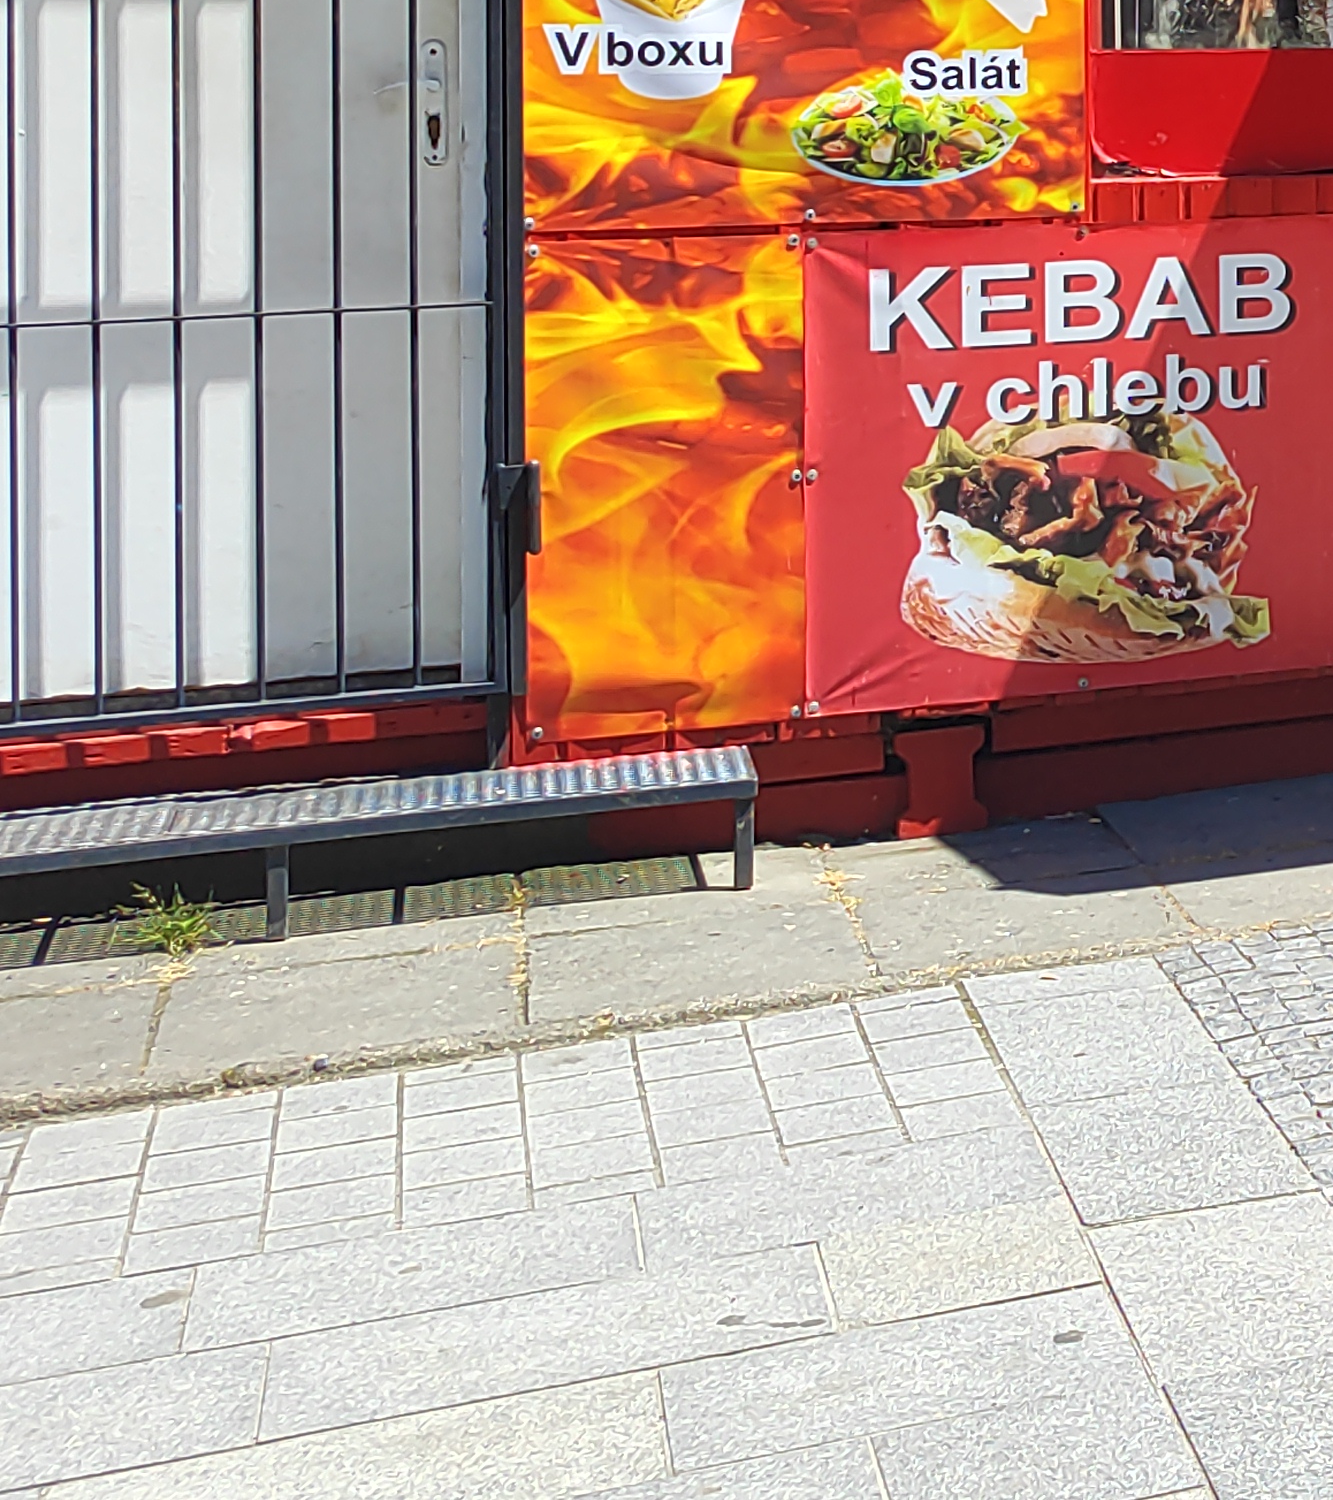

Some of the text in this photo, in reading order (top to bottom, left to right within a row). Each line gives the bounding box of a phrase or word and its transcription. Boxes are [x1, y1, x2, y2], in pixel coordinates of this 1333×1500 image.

[555, 29, 725, 67] V boxu
[909, 52, 1022, 92] Salát
[868, 252, 1296, 354] KEBAB
[907, 353, 1269, 429] v chlebu
